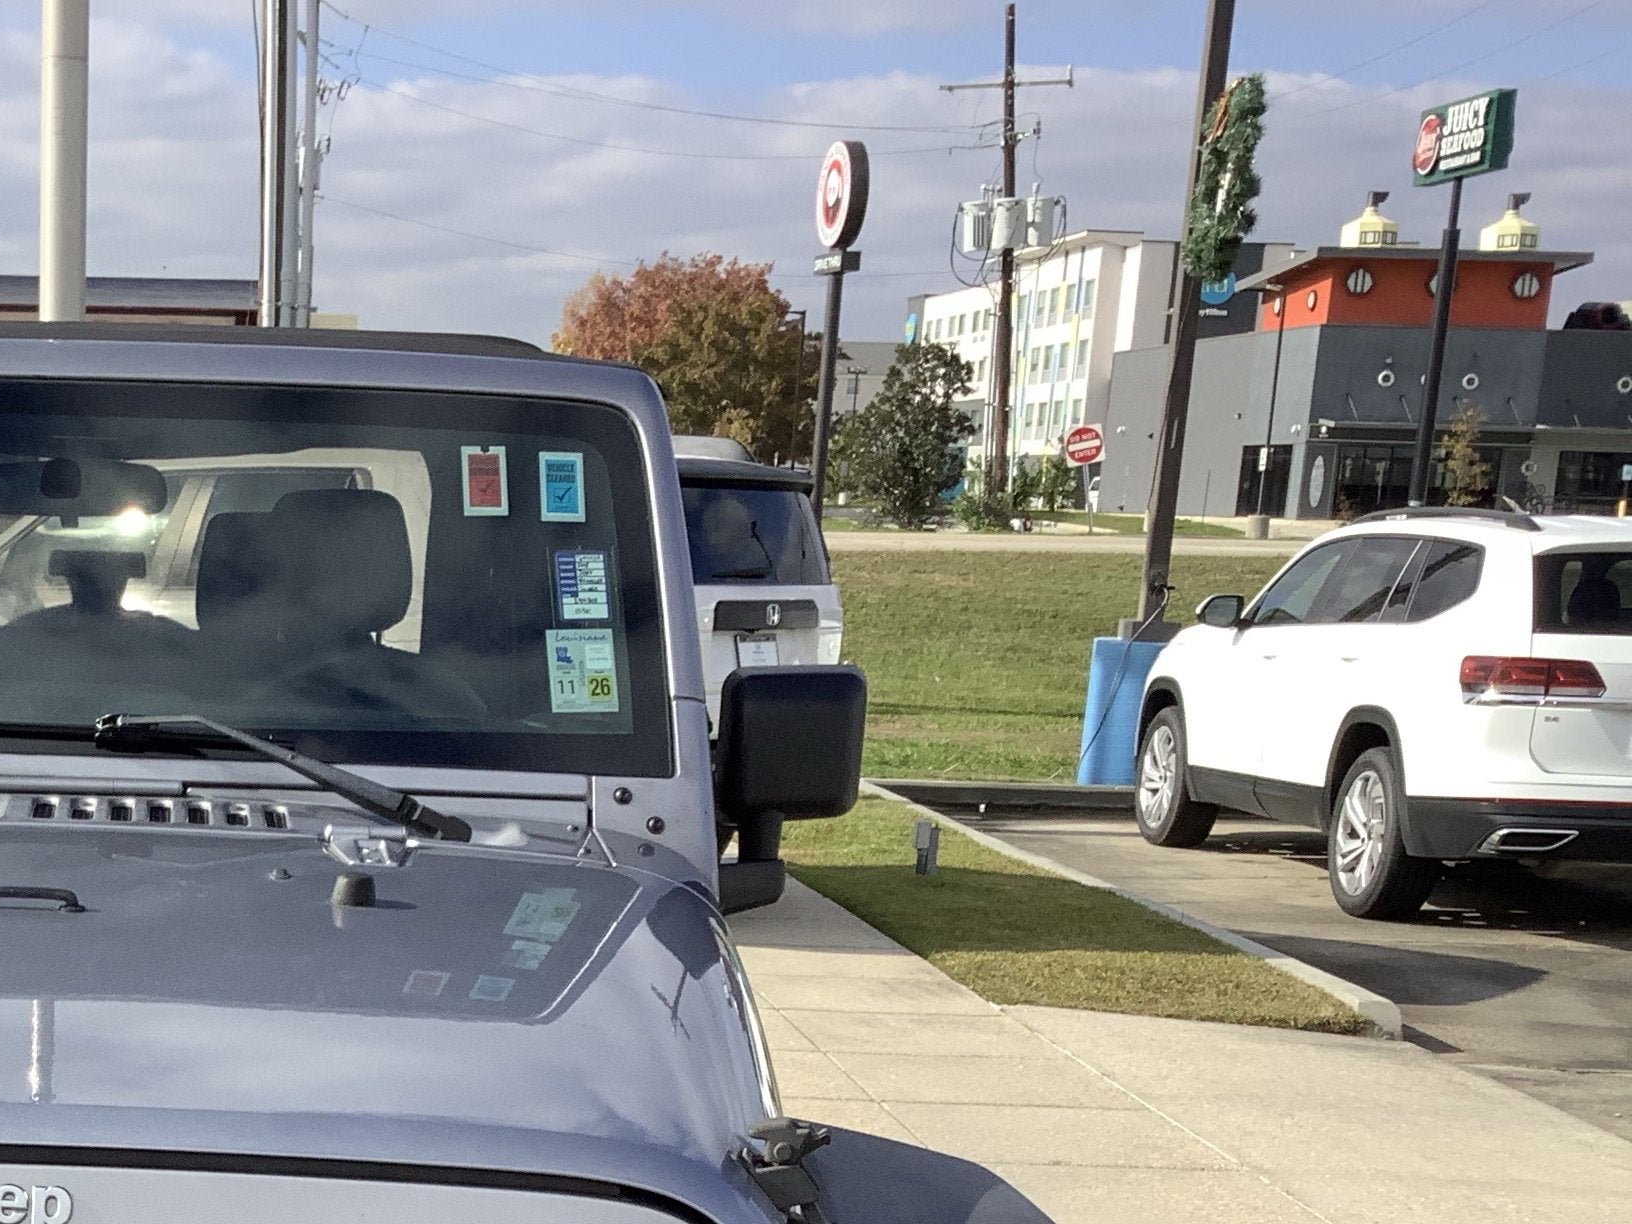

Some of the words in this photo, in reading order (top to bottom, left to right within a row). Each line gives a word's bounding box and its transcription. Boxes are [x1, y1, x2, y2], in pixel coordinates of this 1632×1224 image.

[1442, 97, 1490, 136] JUICY
[1440, 127, 1485, 157] SEAFOOD
[1069, 435, 1081, 443] DO
[1081, 432, 1096, 440] NOT
[1075, 448, 1097, 459] ENTER
[557, 680, 575, 694] 11
[590, 677, 611, 696] 26
